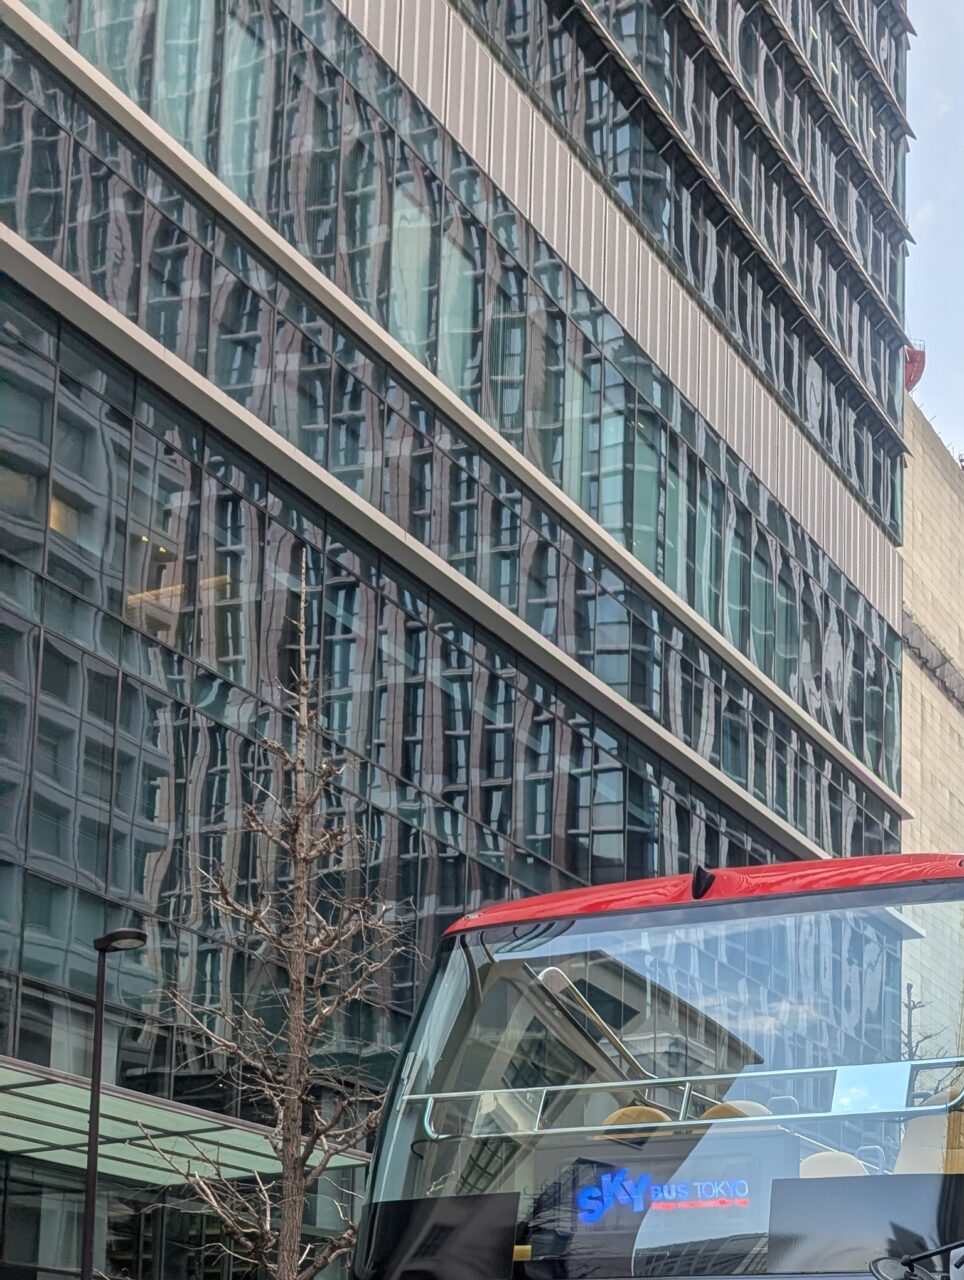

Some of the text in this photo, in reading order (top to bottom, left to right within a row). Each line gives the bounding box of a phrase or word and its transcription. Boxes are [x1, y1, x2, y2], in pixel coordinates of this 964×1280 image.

[577, 1168, 652, 1225] SKY
[652, 1183, 690, 1200] BUS
[694, 1179, 749, 1198] TOKYO
